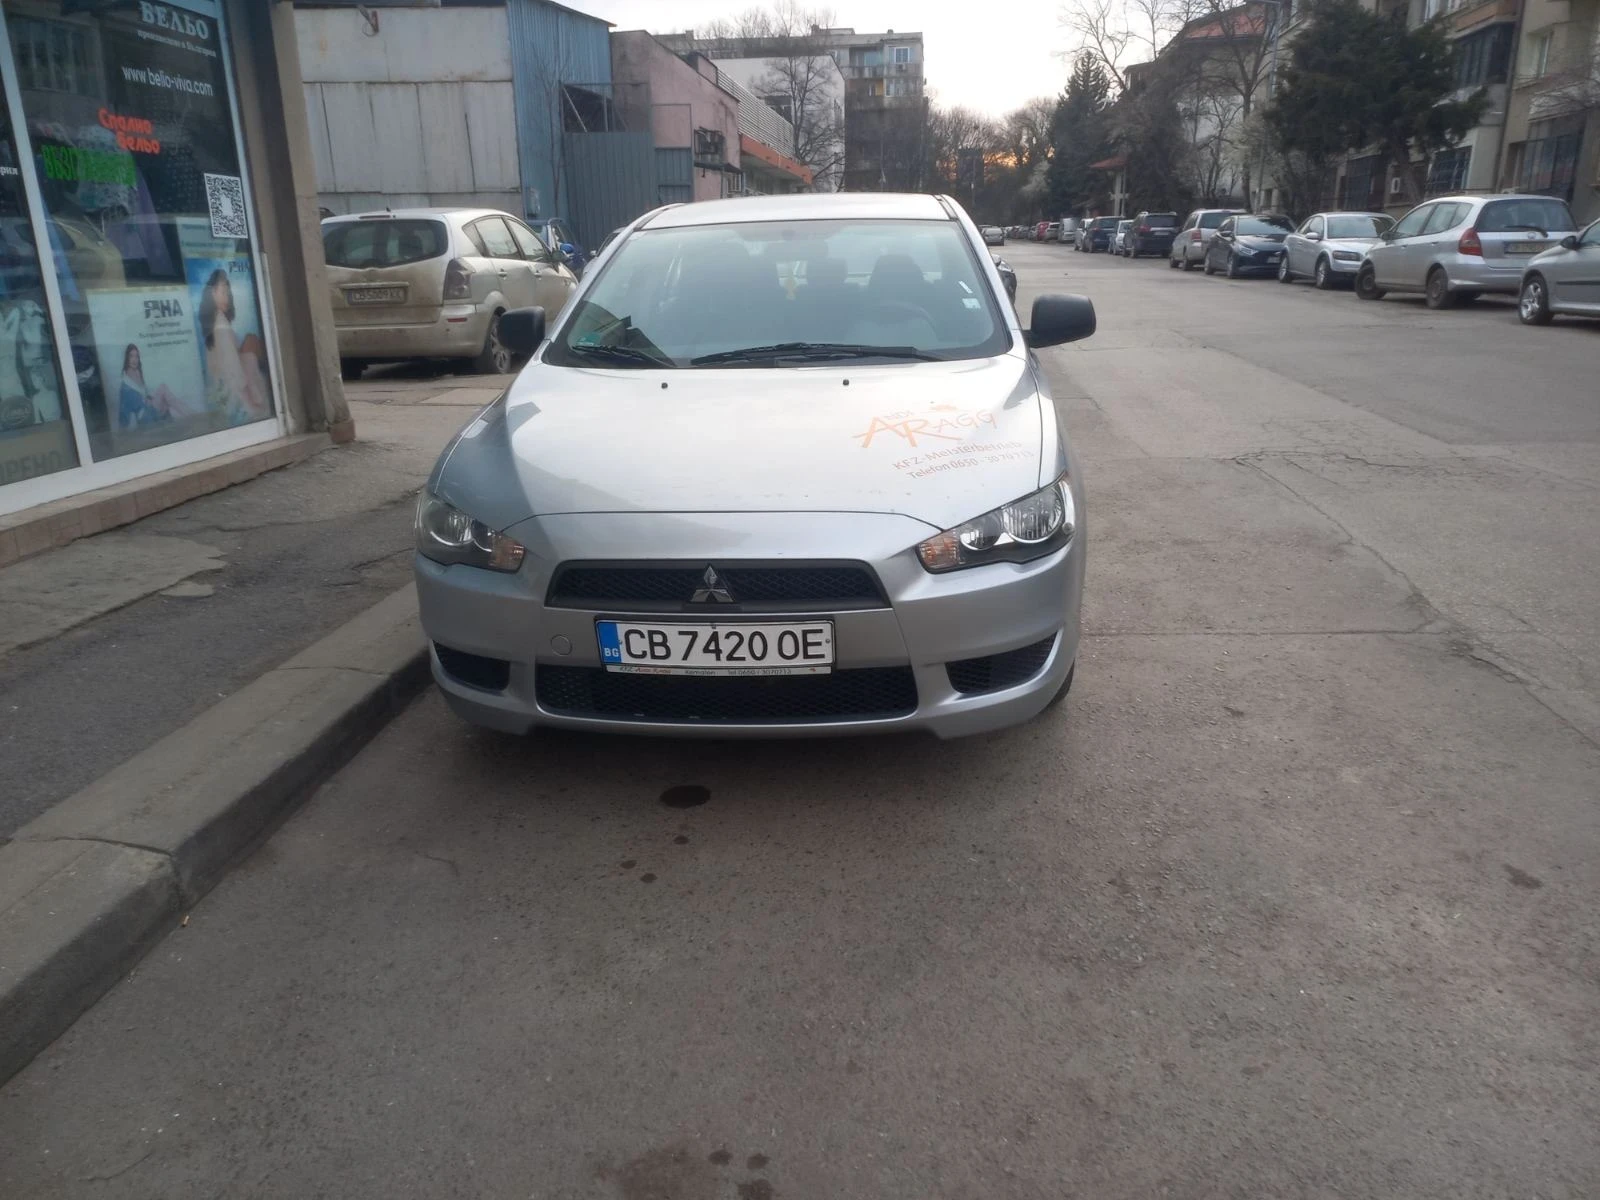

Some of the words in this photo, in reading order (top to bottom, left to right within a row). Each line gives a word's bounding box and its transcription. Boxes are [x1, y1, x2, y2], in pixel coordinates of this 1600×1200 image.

[905, 463, 951, 480] Telefon
[604, 647, 620, 658] BG
[624, 629, 672, 662] CB
[678, 630, 769, 662] 7420
[777, 629, 826, 661] OE
